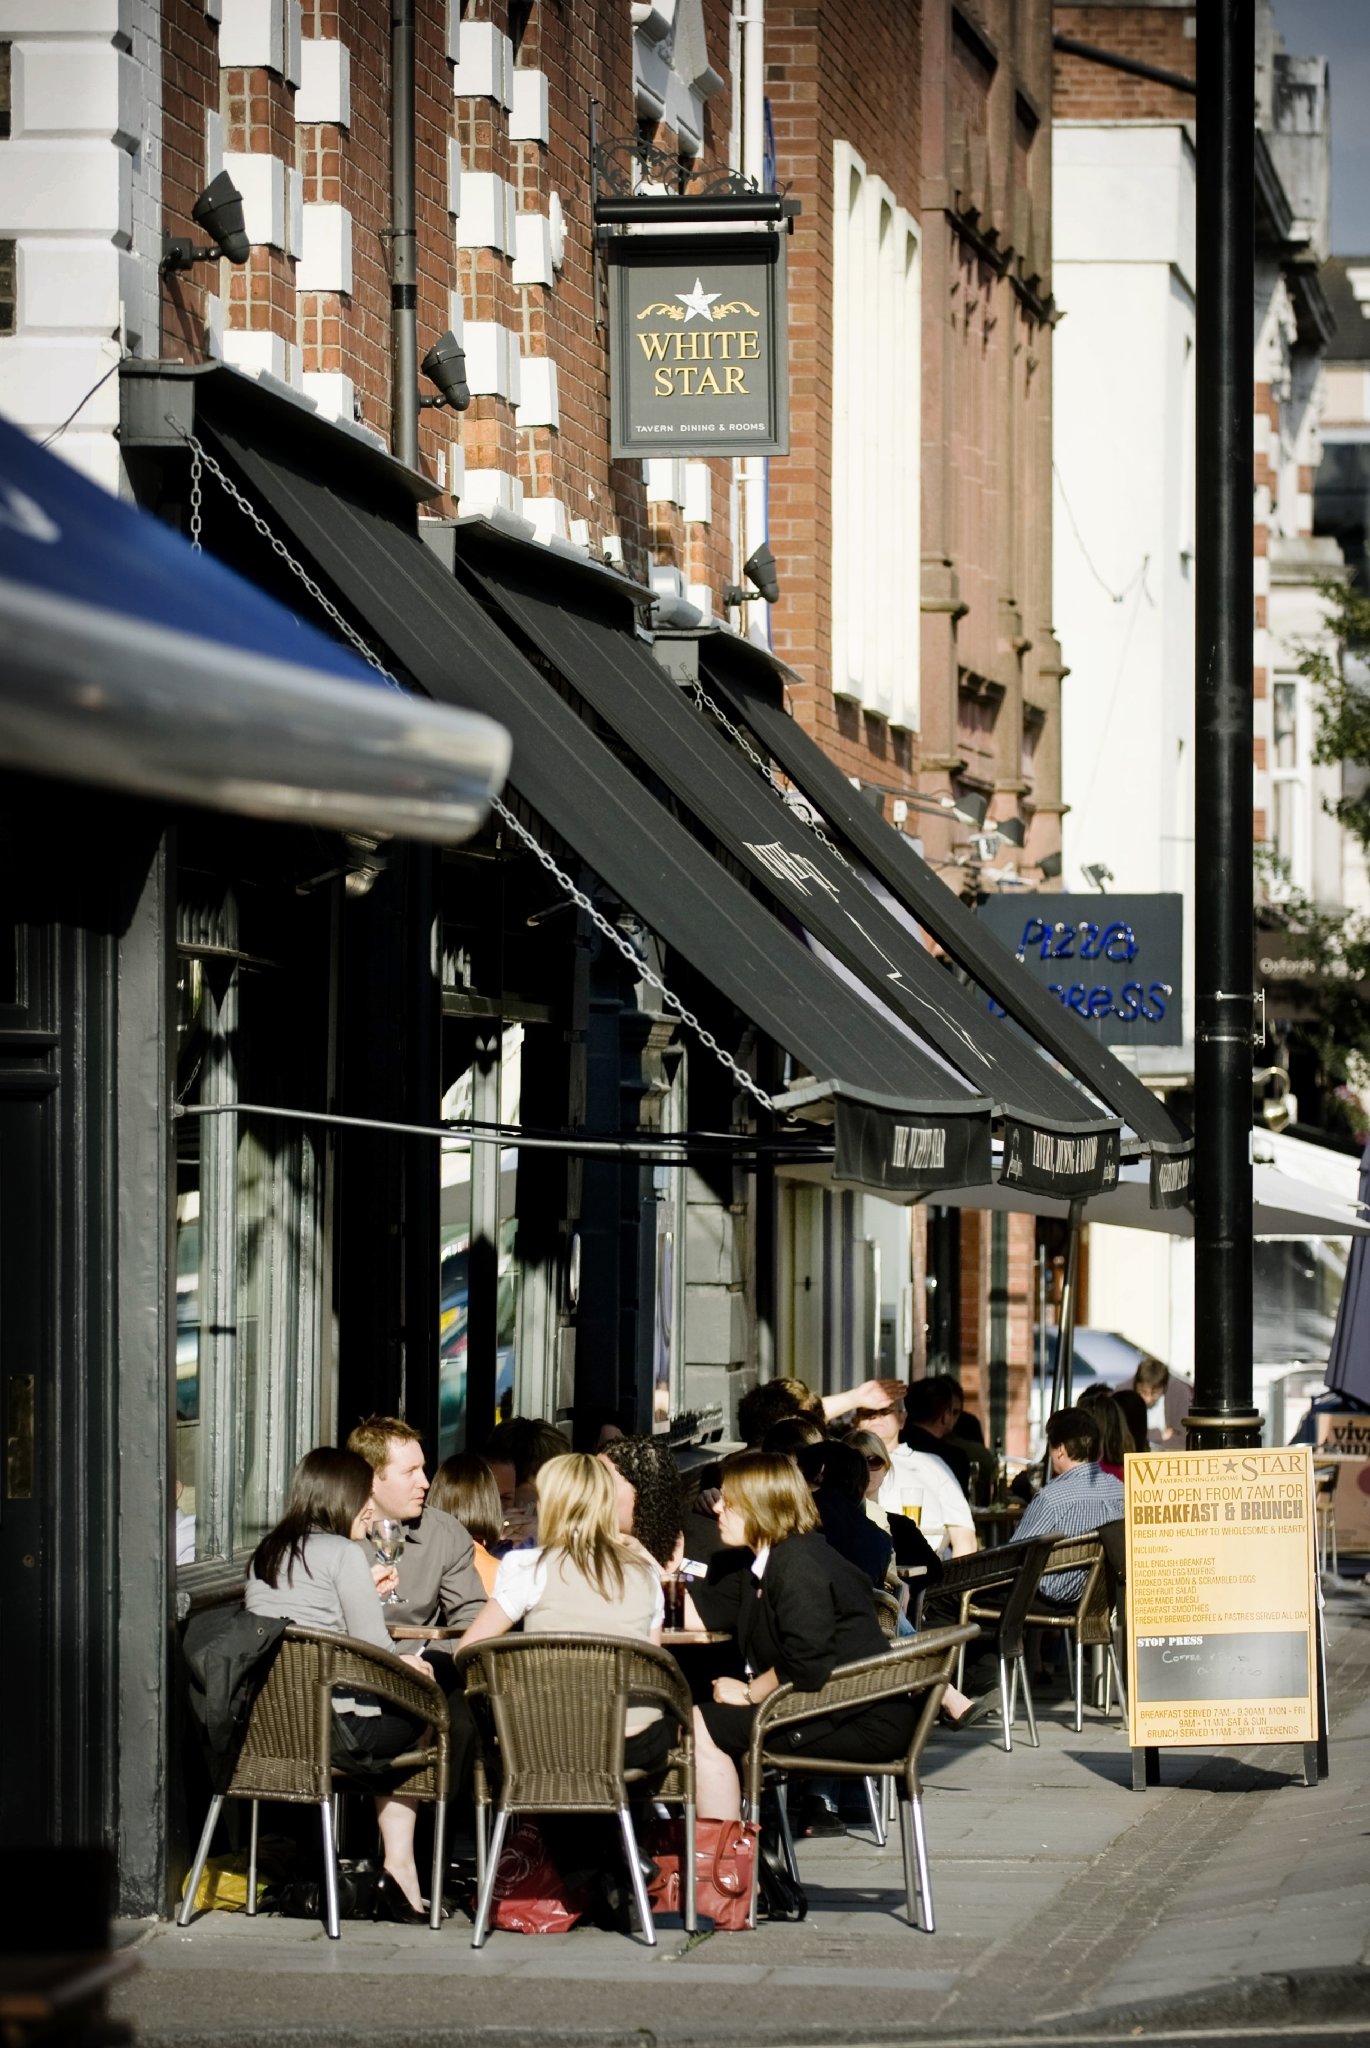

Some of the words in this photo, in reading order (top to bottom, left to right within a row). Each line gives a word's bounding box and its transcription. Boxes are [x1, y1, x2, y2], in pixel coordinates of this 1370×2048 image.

[637, 331, 761, 361] WHITE
[654, 366, 750, 396] STAR
[636, 425, 673, 433] TAVERN
[680, 424, 715, 432] DINING
[729, 423, 765, 431] ROOMS
[1132, 1458, 1220, 1485] WHITE
[1242, 1455, 1304, 1482] STAR
[1134, 1489, 1163, 1503] NOW
[1168, 1488, 1201, 1502] OPEN
[1206, 1486, 1243, 1501] FROM
[1247, 1485, 1274, 1499] 7AM
[1279, 1484, 1303, 1498] FOR
[1133, 1503, 1219, 1525] BREAKFAST
[1225, 1502, 1235, 1521] &
[1241, 1500, 1303, 1520] BRUNCH
[1134, 1530, 1157, 1538] FRESH
[1159, 1529, 1174, 1537] AND
[1176, 1528, 1208, 1537] HEALTHY
[1211, 1527, 1219, 1536] TO
[1222, 1526, 1269, 1535] WHOLESOME
[1279, 1524, 1306, 1534] HEARTY
[1151, 1559, 1179, 1567] ENGLISH
[1180, 1558, 1215, 1566] BREAKFAST
[1135, 1569, 1156, 1577] BACON
[1158, 1569, 1171, 1577] AND
[1173, 1568, 1185, 1576] EGG
[1187, 1567, 1215, 1576] MUFFINS
[1135, 1579, 1162, 1587] SMOKED
[1163, 1577, 1190, 1586] SALMON
[1199, 1576, 1237, 1585] SCRAMBLED
[1240, 1575, 1256, 1583] EGGS
[1135, 1588, 1154, 1596] FRESH
[1156, 1587, 1173, 1595] FRUIT
[1176, 1586, 1196, 1594] SALAD
[1135, 1597, 1153, 1605] HOME
[1176, 1596, 1199, 1604] MUESLI
[1135, 1606, 1170, 1614] BREAKFAST
[1172, 1604, 1209, 1613] SMOOTHIES
[1136, 1616, 1163, 1624] FRESHLY
[1165, 1615, 1190, 1623] BREWED
[1192, 1614, 1216, 1622] COFFEE
[1225, 1612, 1254, 1621] PASTRIES
[1256, 1611, 1280, 1620] SERVED
[1282, 1611, 1293, 1619] ALL
[1295, 1611, 1307, 1619] DAY
[1137, 1638, 1165, 1647] STOP
[1168, 1636, 1203, 1646] PRESS
[1141, 1710, 1182, 1719] BREAKFAST
[1184, 1709, 1211, 1718] SERVED
[1214, 1708, 1230, 1717] 7AM
[1269, 1706, 1286, 1715] MON
[1294, 1706, 1305, 1714] FRI
[1179, 1719, 1195, 1727] 9AM
[1227, 1718, 1241, 1726] SAT
[1252, 1717, 1266, 1725] SUN
[1147, 1729, 1178, 1738] BRUNCH
[1180, 1728, 1208, 1737] SERVED
[1211, 1728, 1231, 1736] 11AM
[1238, 1727, 1254, 1735] 3PM
[1259, 1726, 1299, 1735] WEEKENDS
